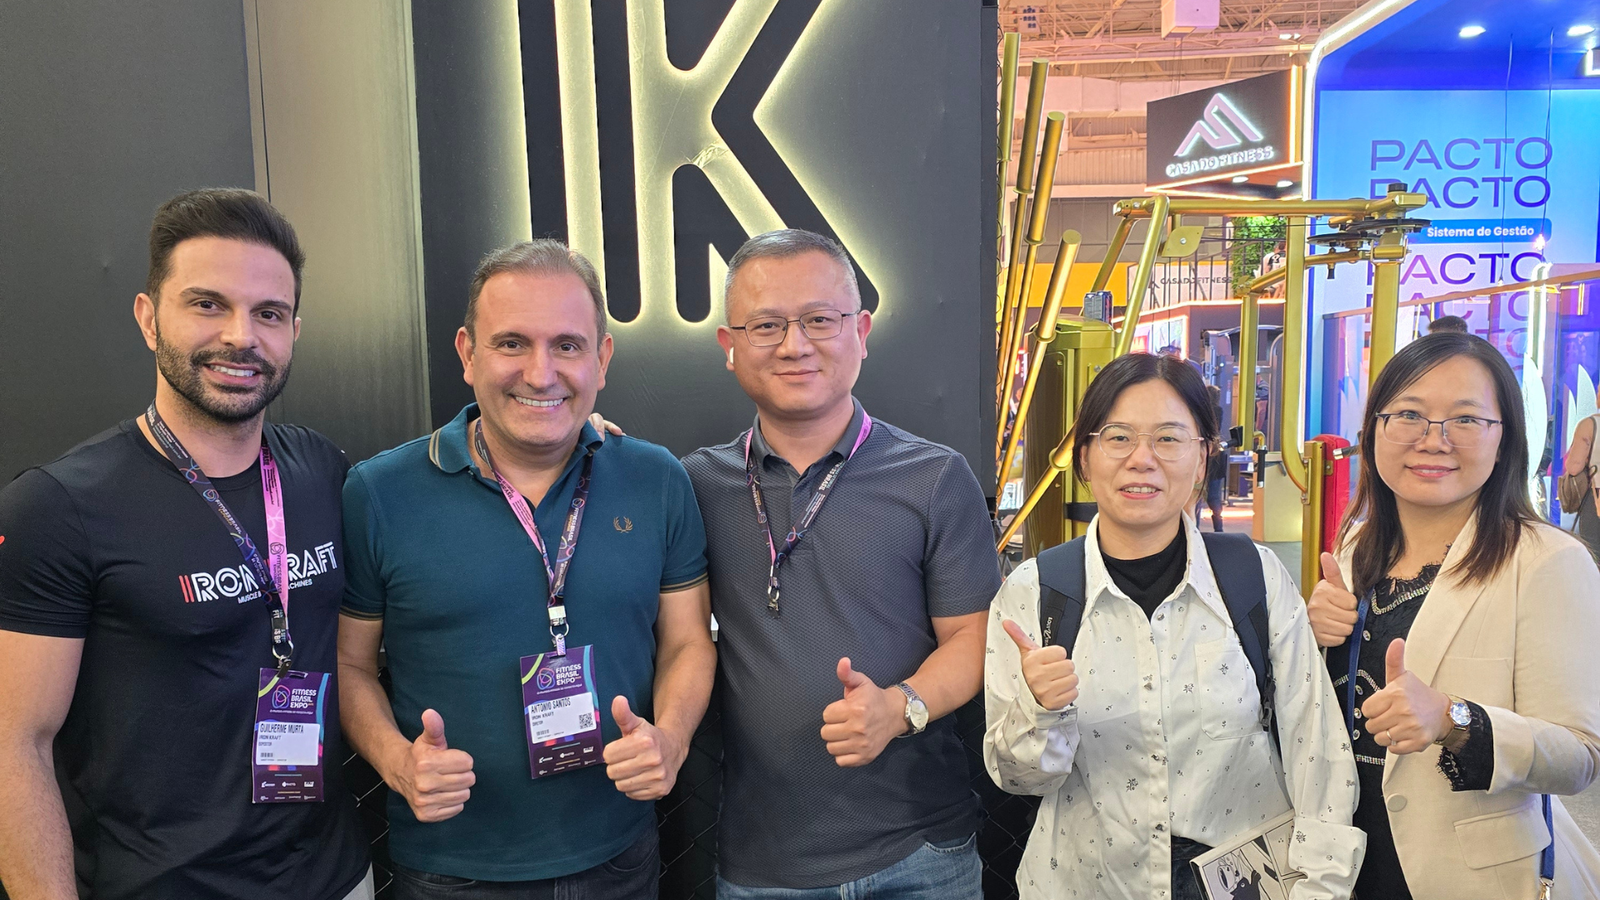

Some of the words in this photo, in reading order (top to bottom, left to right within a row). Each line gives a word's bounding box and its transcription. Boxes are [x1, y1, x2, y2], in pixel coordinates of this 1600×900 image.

[1218, 146, 1275, 167] FITNESS
[1370, 137, 1553, 171] PACTO
[1427, 226, 1476, 237] Sistema
[1477, 226, 1492, 236] de
[1493, 225, 1535, 237] Gestão
[1367, 252, 1547, 285] ACTO
[263, 541, 338, 580] RAFT
[237, 591, 258, 604] MUSCLE
[288, 578, 313, 590] CHINES
[556, 663, 582, 673] FITNESS
[556, 670, 580, 679] BRASIL
[556, 677, 576, 686] EXPO
[292, 688, 317, 696] FITNESS
[531, 702, 552, 713] ANTONIO
[552, 697, 571, 709] SANTOS
[260, 723, 287, 734] GUILHERME
[288, 724, 304, 734] MURTA
